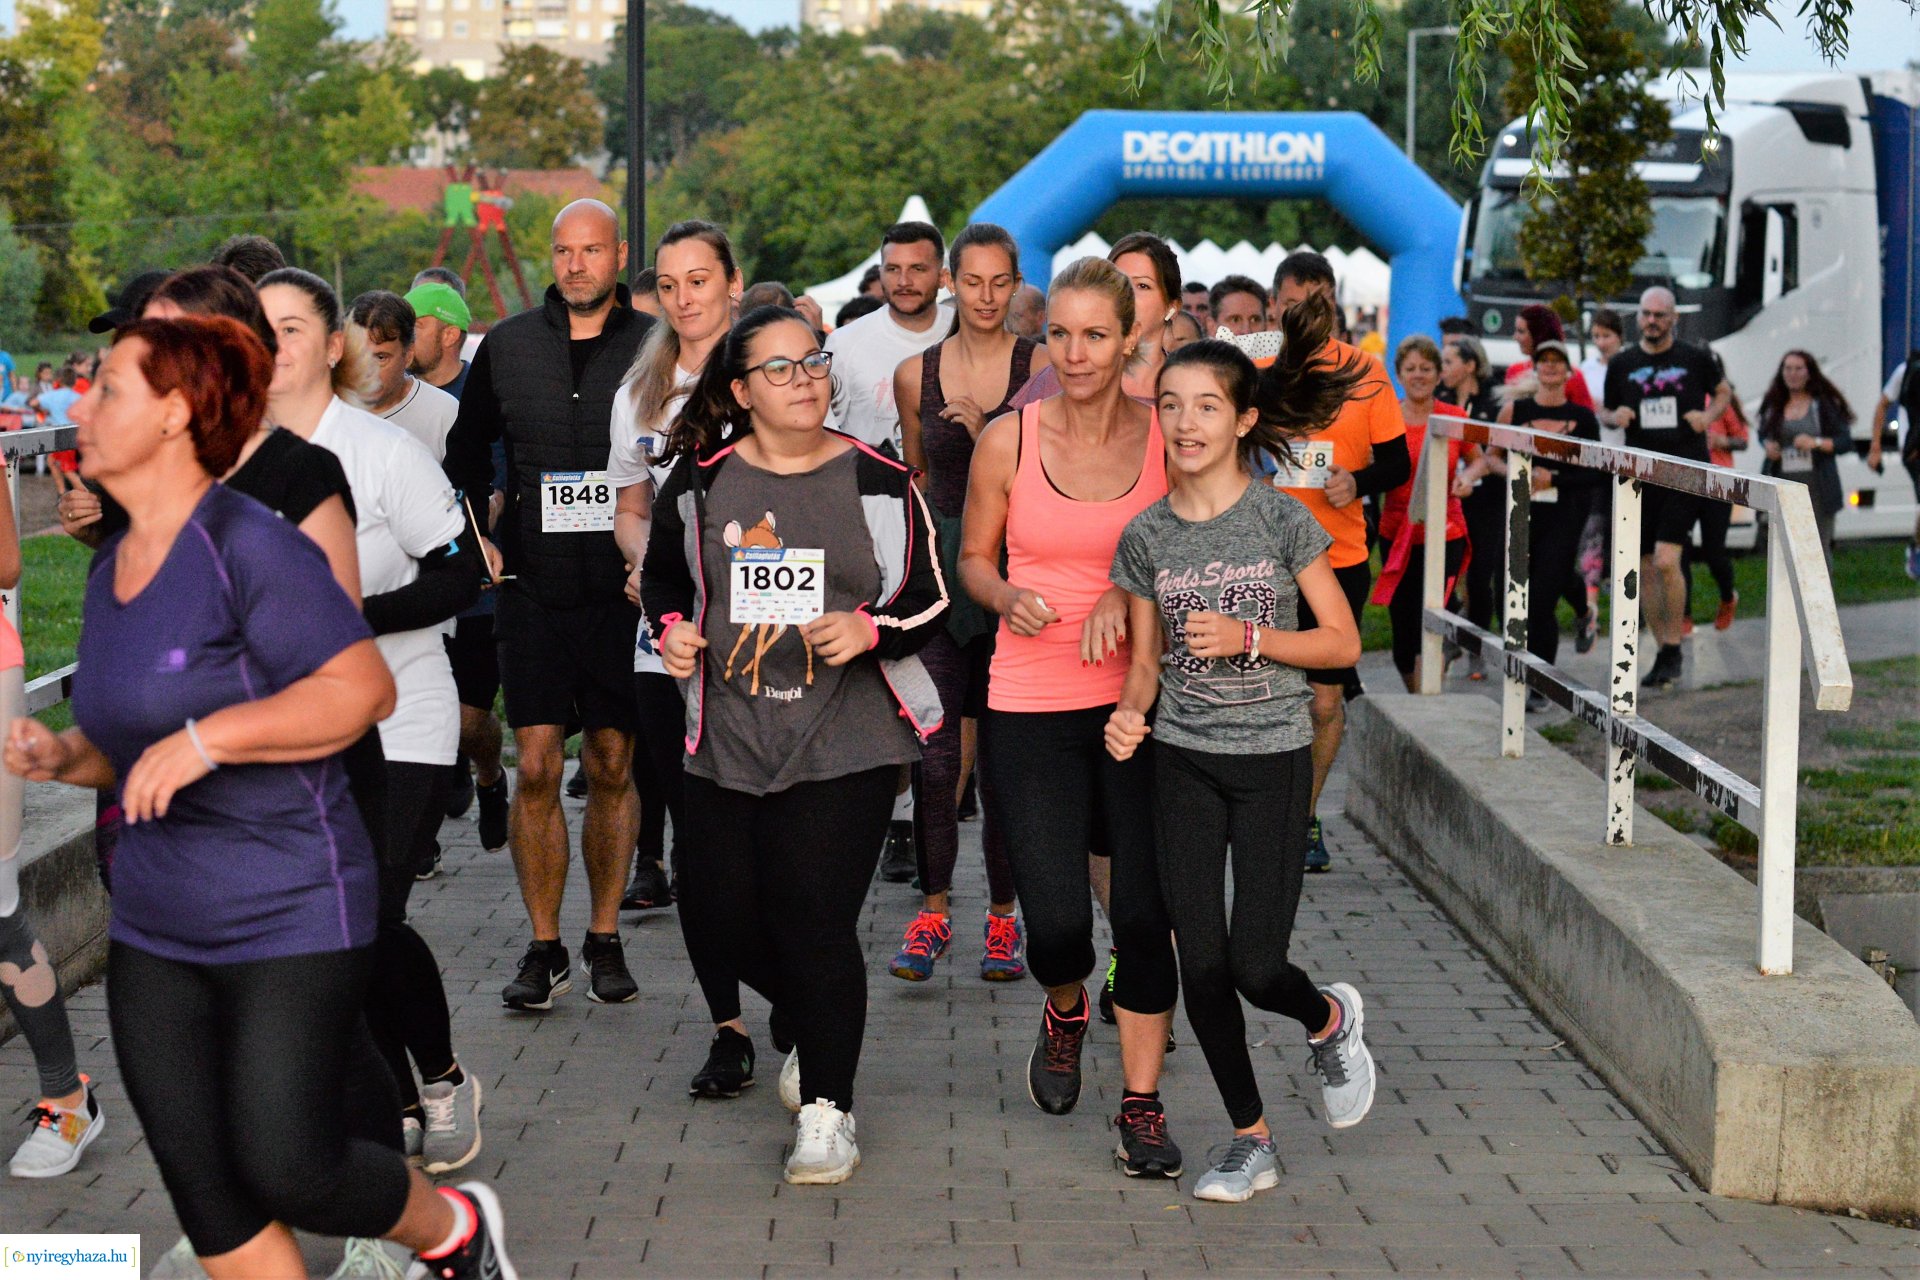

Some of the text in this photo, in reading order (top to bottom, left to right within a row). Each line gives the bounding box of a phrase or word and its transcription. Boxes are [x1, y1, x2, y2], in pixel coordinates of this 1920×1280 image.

[1122, 130, 1325, 164] DECATHLON
[548, 484, 610, 505] 1848
[739, 565, 815, 590] 1802
[1154, 559, 1275, 600] Girls Sports
[763, 685, 803, 701] Bambi
